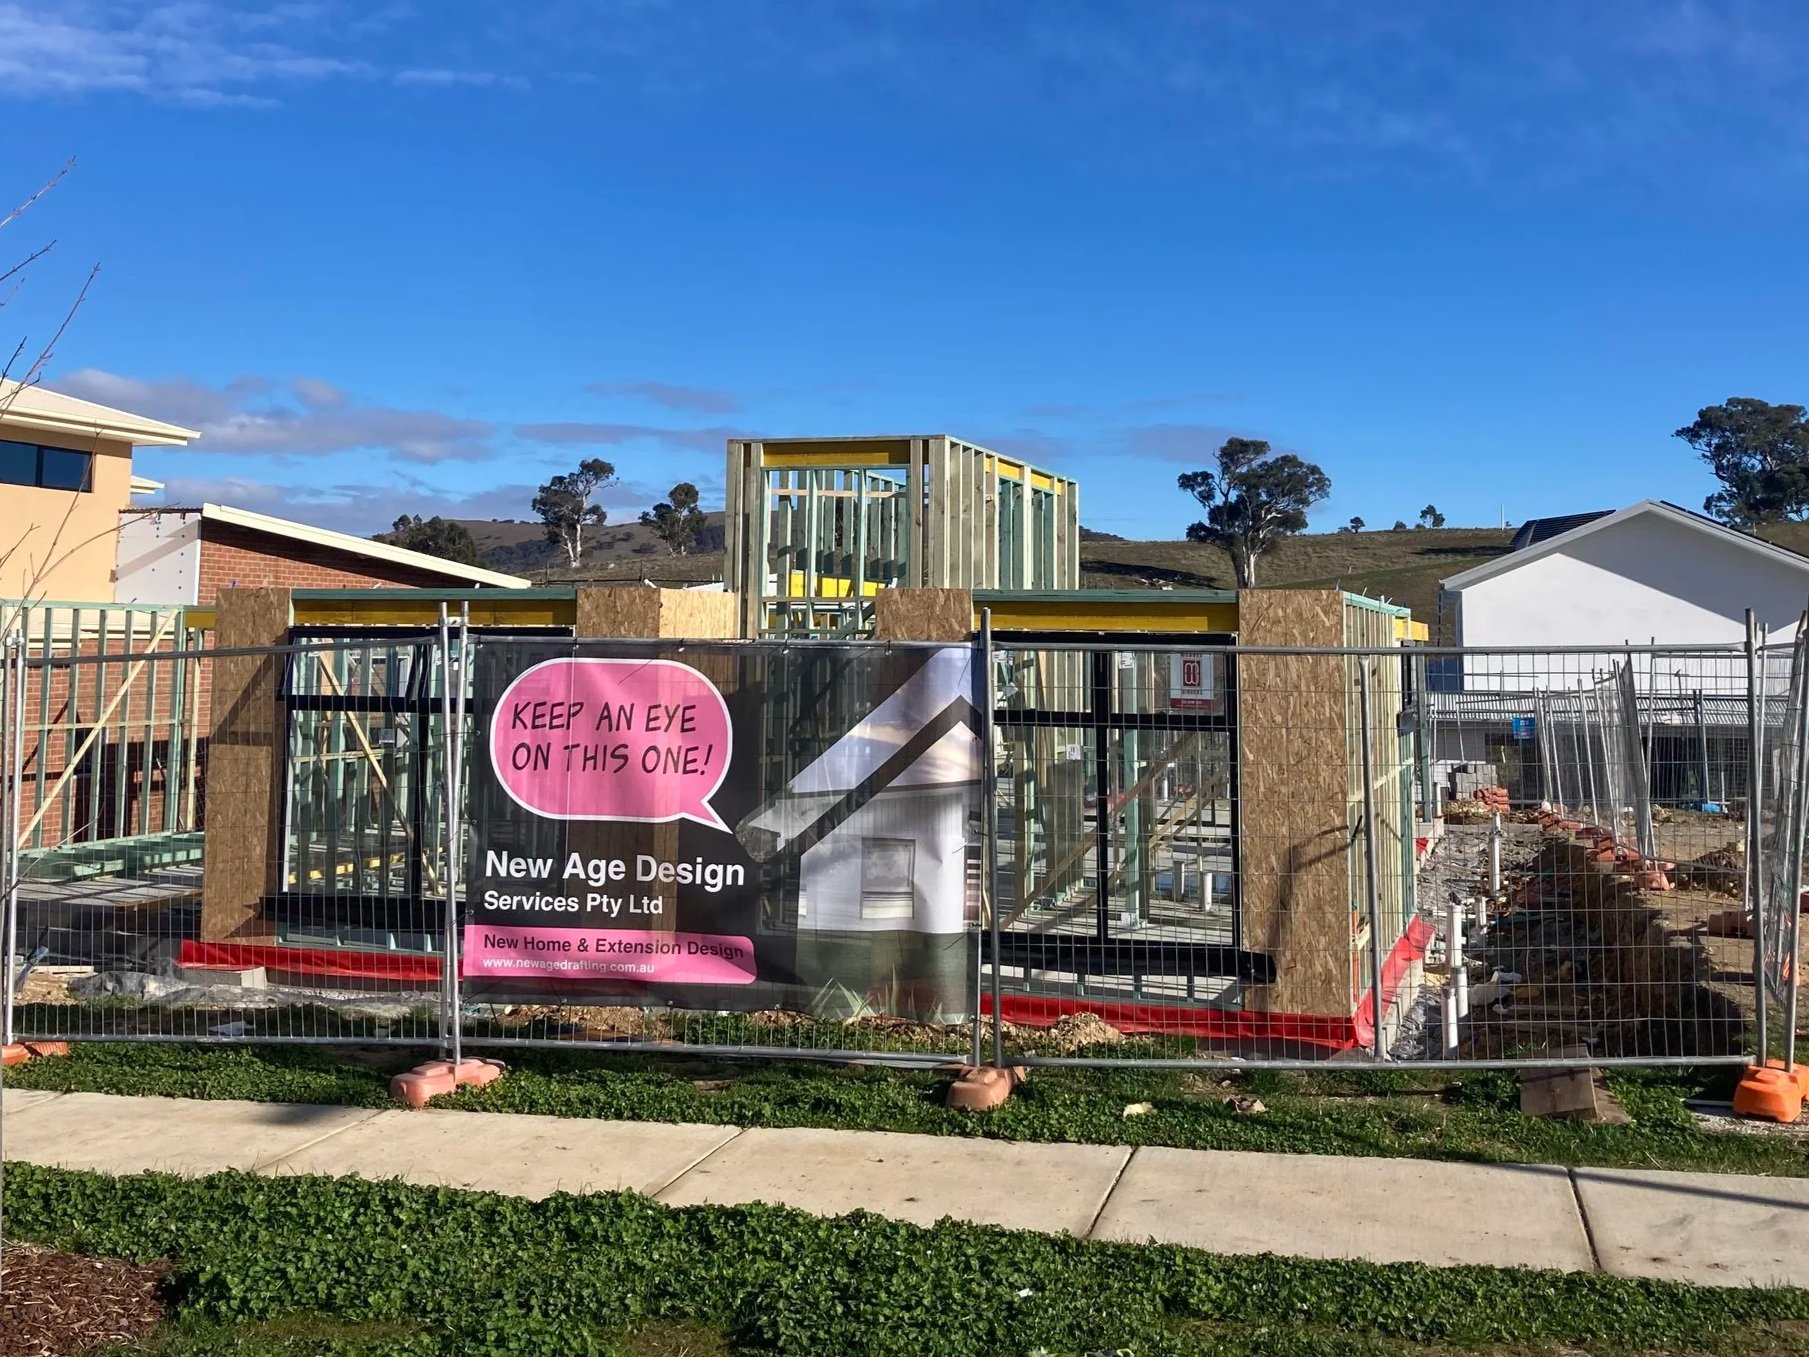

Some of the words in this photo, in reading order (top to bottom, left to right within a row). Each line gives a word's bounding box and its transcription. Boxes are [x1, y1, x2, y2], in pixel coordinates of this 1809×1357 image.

[511, 701, 585, 731] KEEP
[595, 702, 635, 732] AN
[645, 704, 697, 733] EYE
[511, 742, 551, 771] ON
[563, 743, 630, 774] THIS
[641, 744, 713, 776] ONE!
[485, 850, 553, 879] New
[562, 852, 627, 887] Age
[636, 855, 745, 892] Design
[483, 890, 579, 912] Services
[586, 894, 624, 917] Pty
[629, 895, 663, 915] Ltd
[484, 934, 519, 949] New
[523, 936, 572, 952] Home
[577, 938, 589, 952] &
[595, 938, 682, 955] Extension
[687, 941, 744, 959] Design
[482, 957, 656, 973] www.newagedrafting.com.au
